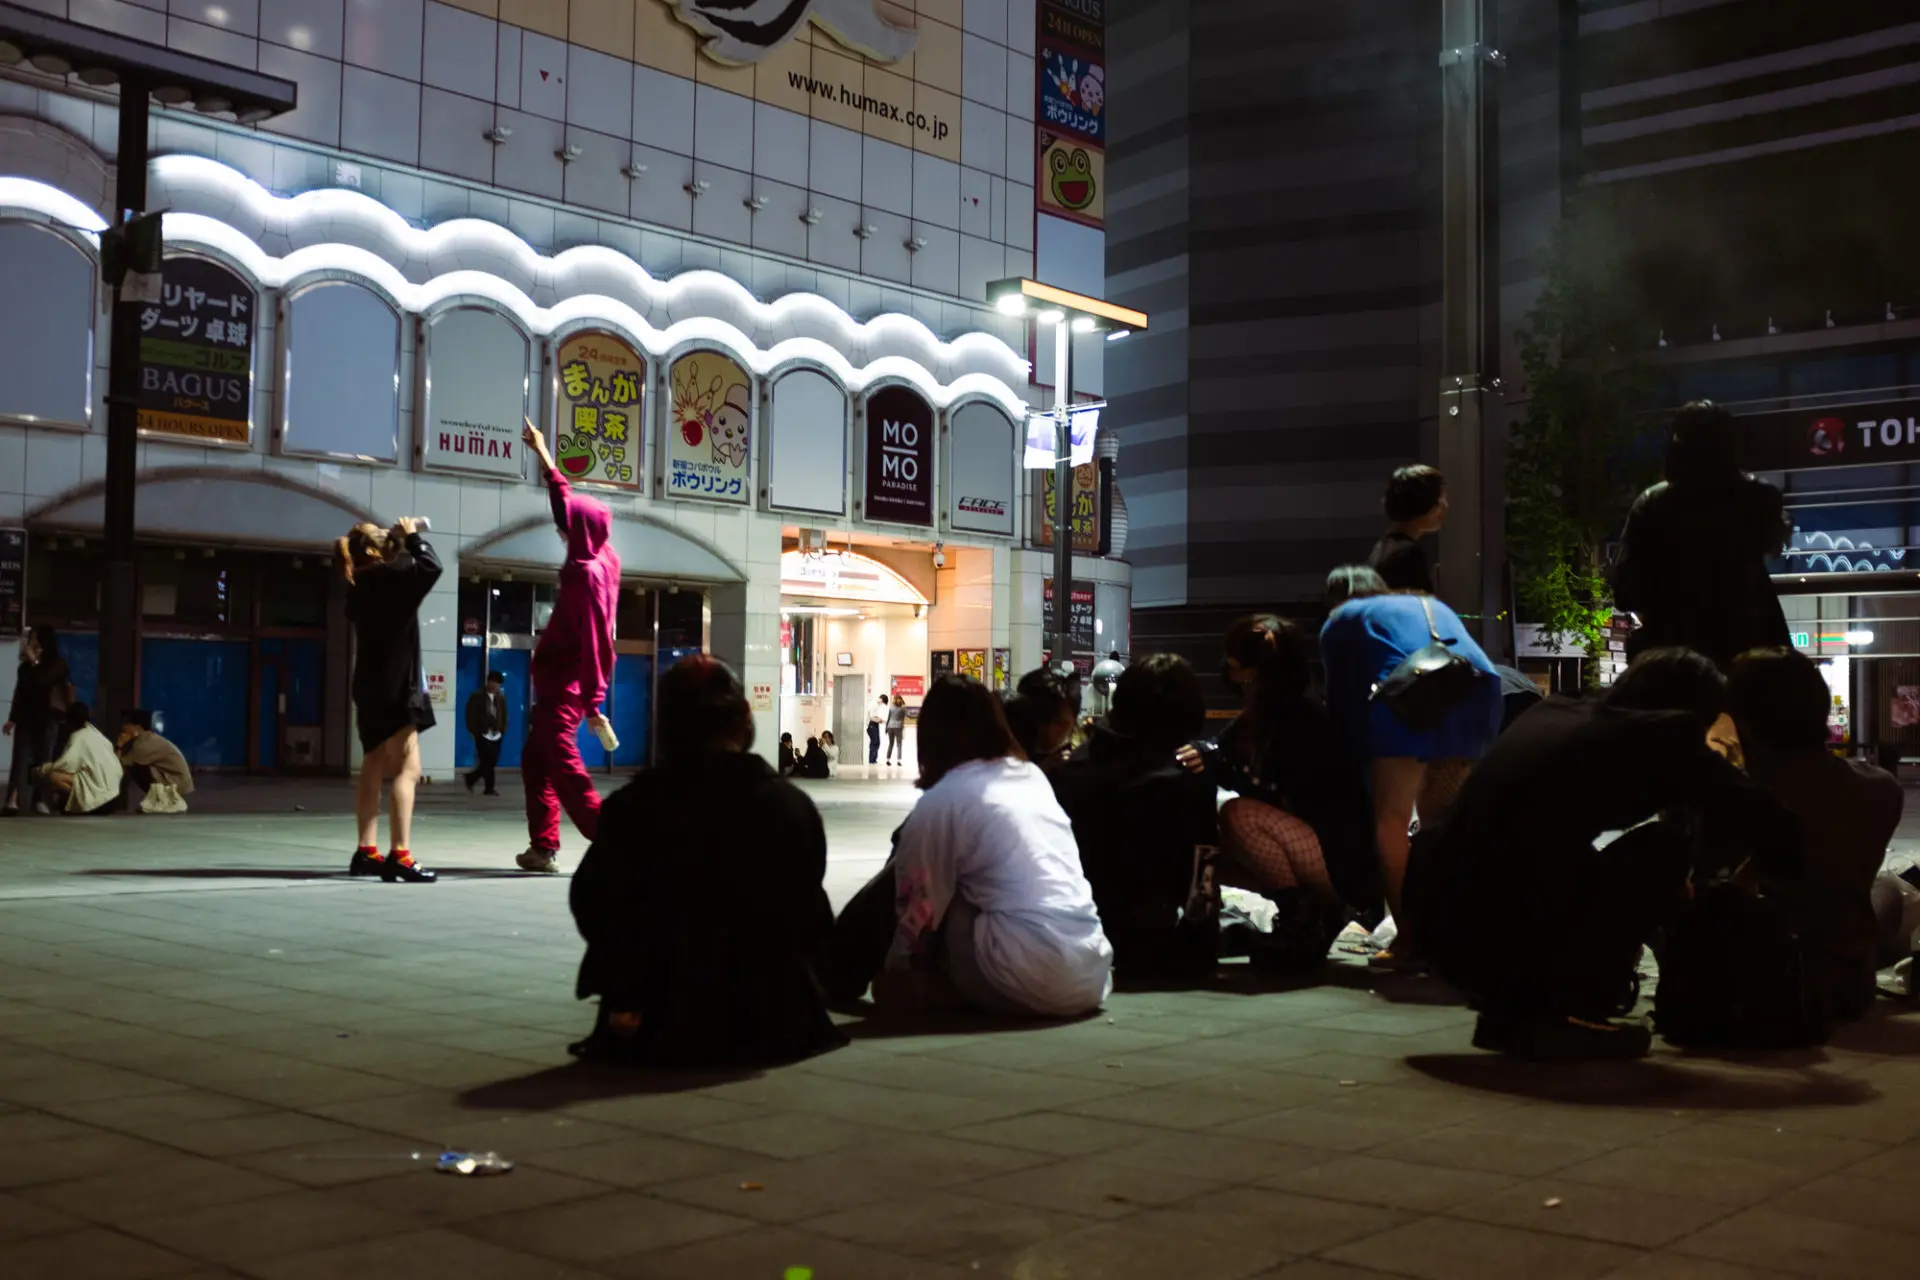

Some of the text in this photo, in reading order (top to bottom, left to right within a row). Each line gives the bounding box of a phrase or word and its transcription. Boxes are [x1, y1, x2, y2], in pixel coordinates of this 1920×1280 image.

[788, 71, 948, 140] www.humax.co.jp
[163, 284, 247, 317] リヤード
[140, 307, 247, 346] ダーツ 卓球
[142, 367, 242, 403] BAGUS
[562, 362, 638, 405] まんが
[573, 405, 627, 441] 喫茶
[883, 419, 919, 447] MO
[440, 431, 512, 459] HUMAX
[882, 453, 918, 481] MO
[882, 480, 917, 492] PARADISE
